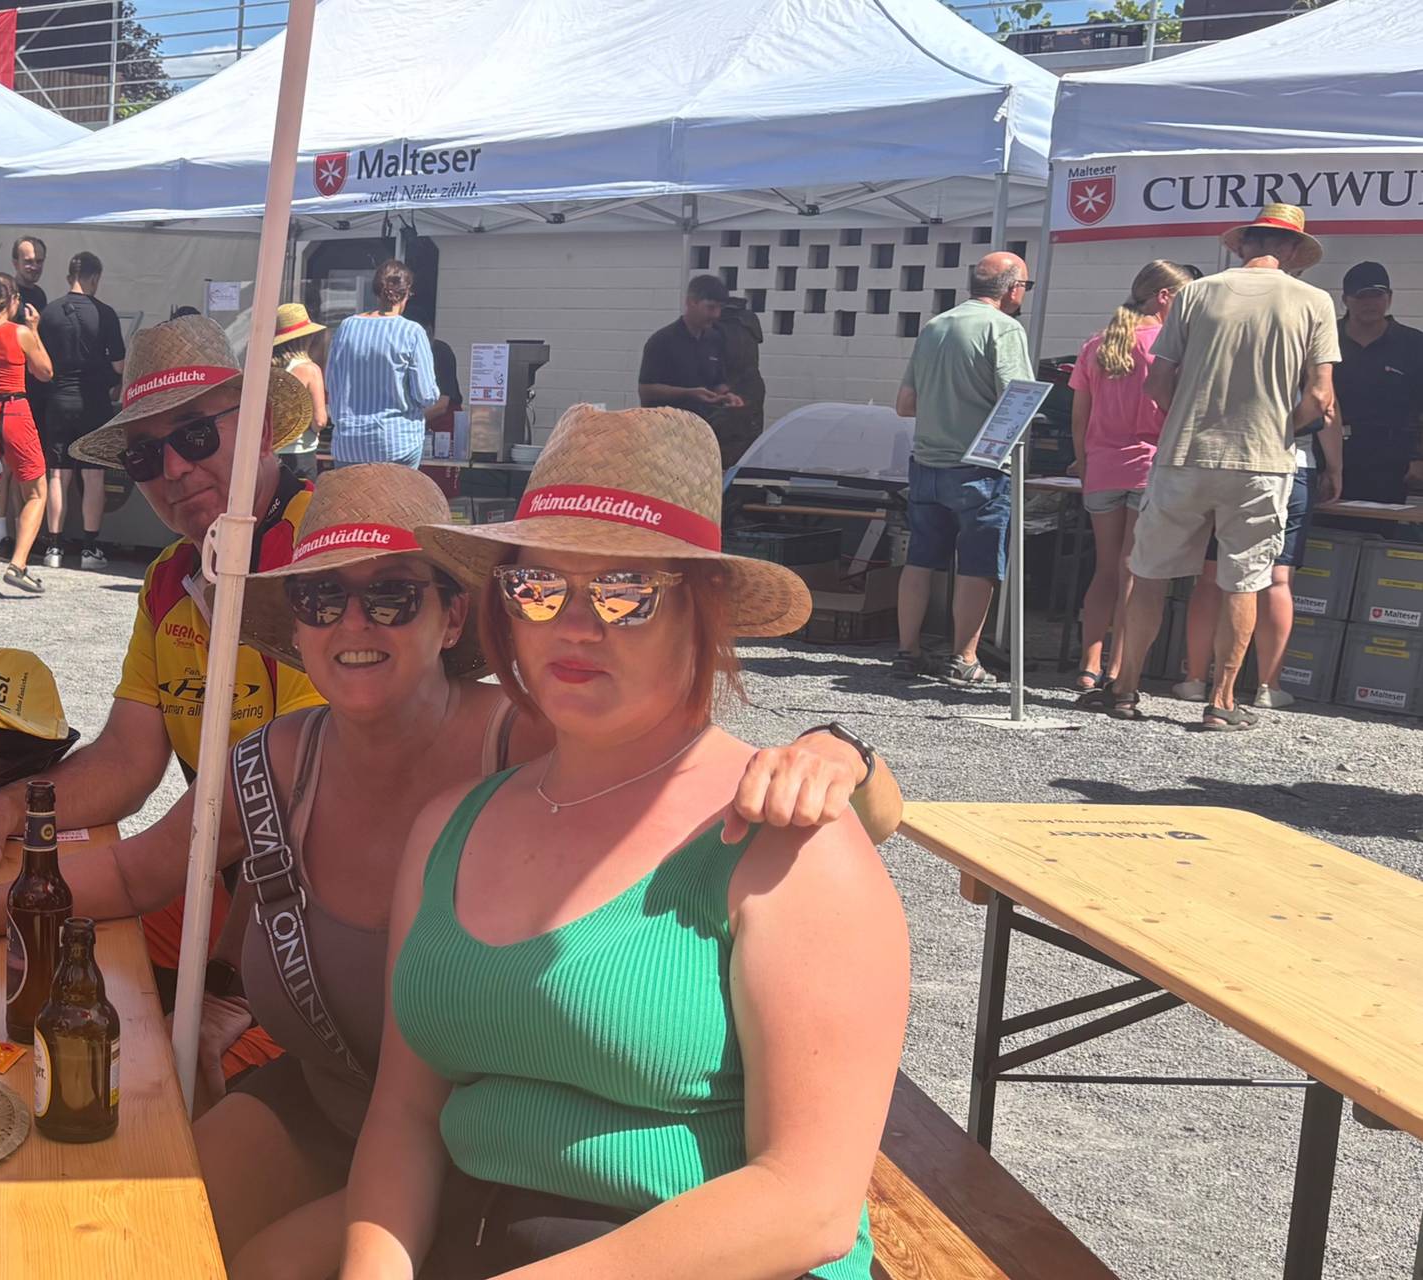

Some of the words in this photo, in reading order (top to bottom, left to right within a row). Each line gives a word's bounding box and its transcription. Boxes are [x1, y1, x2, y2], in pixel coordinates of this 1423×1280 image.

[357, 143, 482, 180] Malteser
[1068, 165, 1117, 178] Malteser
[399, 183, 438, 202] Nähe
[529, 493, 663, 525] Heimatstädtche
[1384, 609, 1419, 621] Malteser
[1369, 689, 1405, 702] Malteser
[1048, 830, 1165, 840] Malteser
